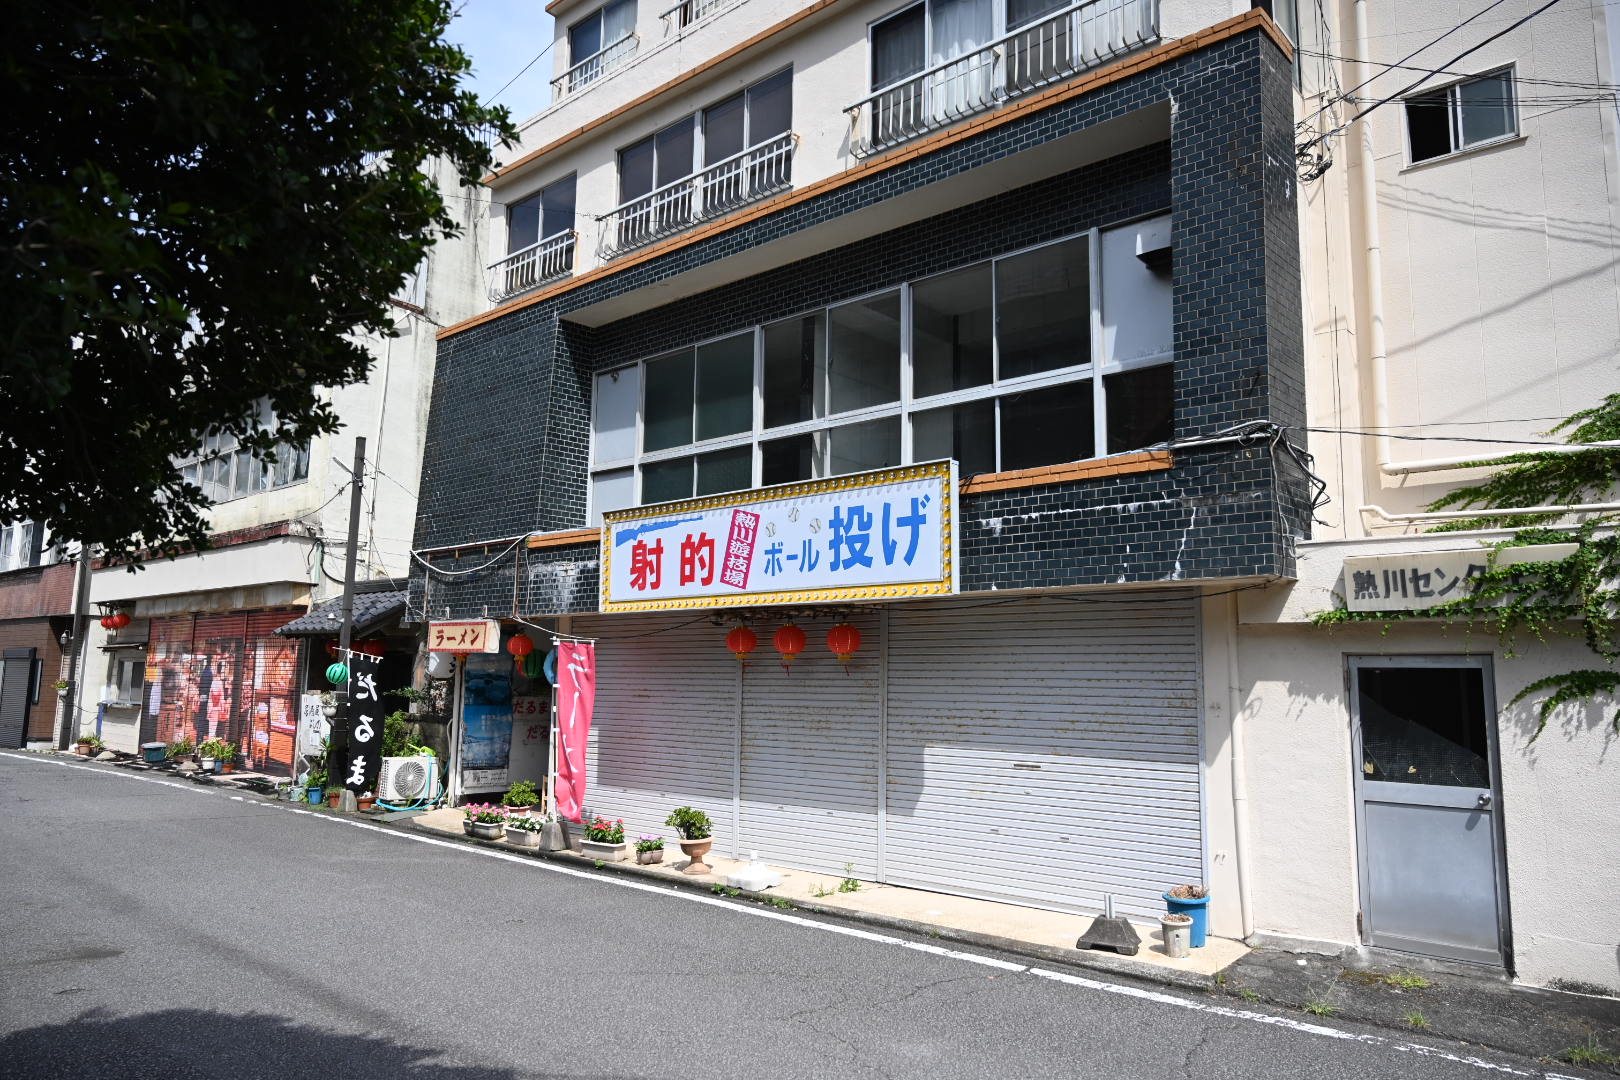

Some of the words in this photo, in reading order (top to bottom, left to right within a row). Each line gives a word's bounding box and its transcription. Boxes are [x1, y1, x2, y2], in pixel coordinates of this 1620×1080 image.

[629, 532, 715, 591] 射的
[723, 511, 756, 587] 熱川遊技場
[763, 494, 931, 577] ボール投げ
[435, 628, 480, 647] ラーメン
[346, 671, 377, 786] だるま
[512, 701, 549, 714] だるま
